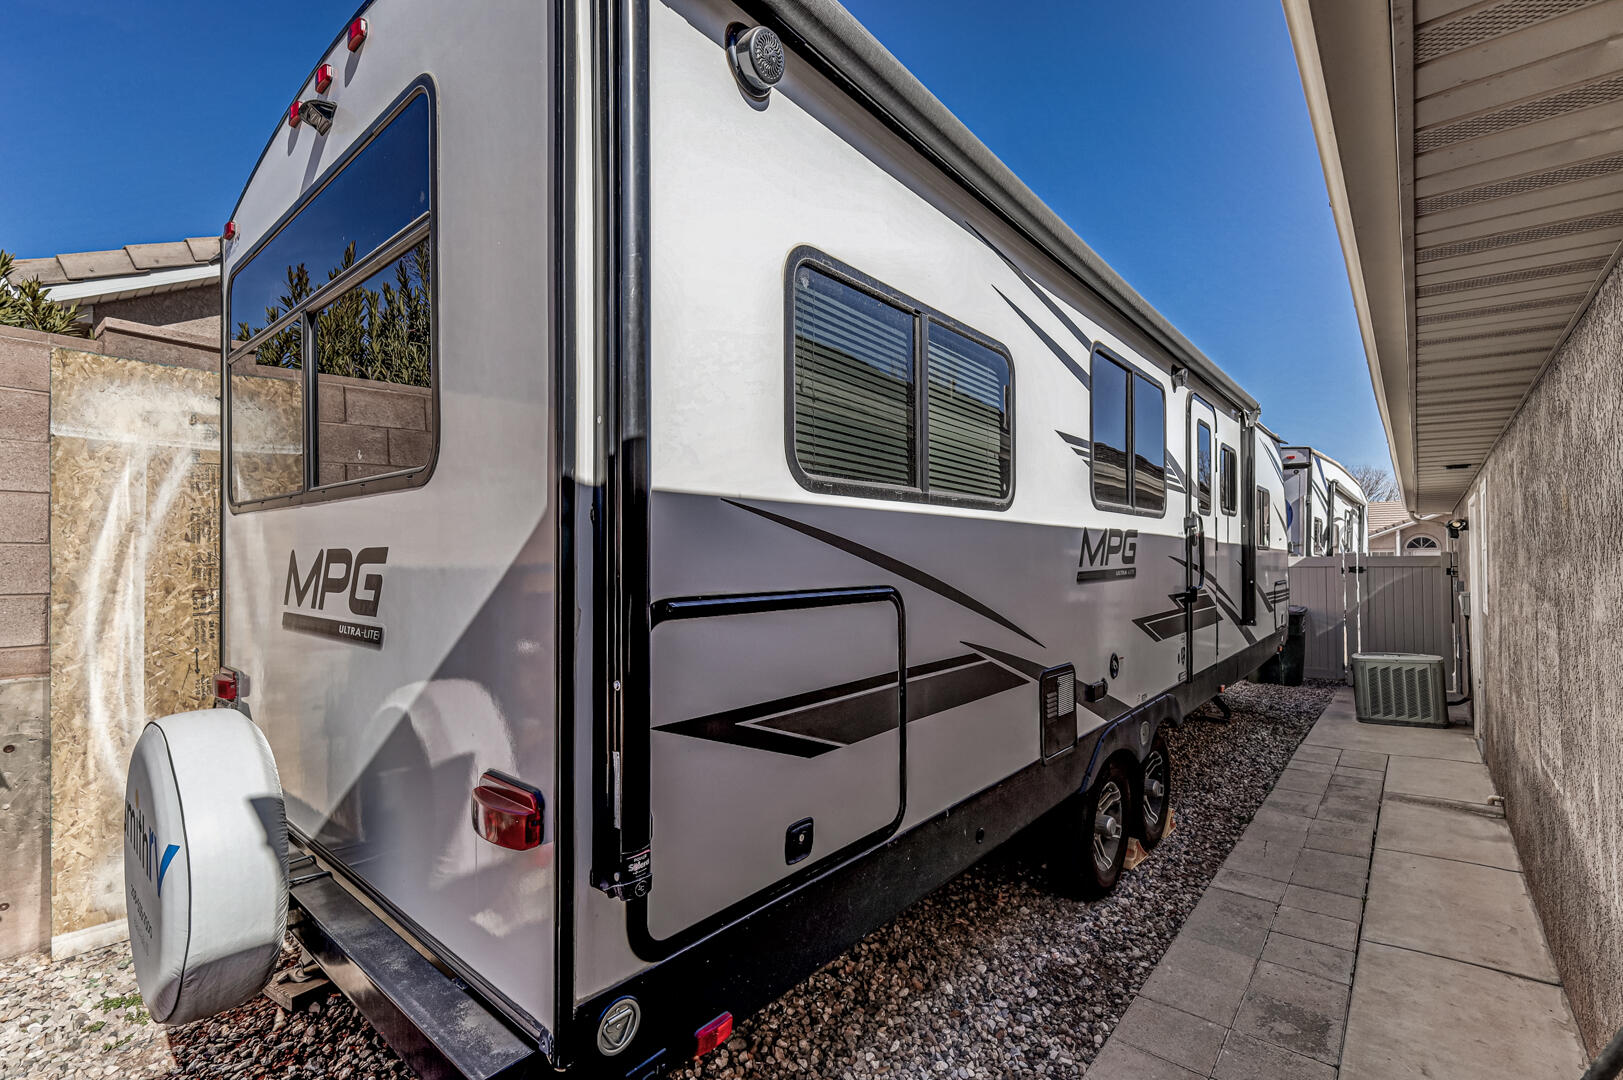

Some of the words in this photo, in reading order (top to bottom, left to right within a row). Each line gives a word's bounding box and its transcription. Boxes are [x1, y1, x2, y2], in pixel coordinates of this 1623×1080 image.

[1079, 527, 1138, 567] MPG
[284, 547, 389, 617] MPG
[338, 624, 381, 640] ULTRA-LITE
